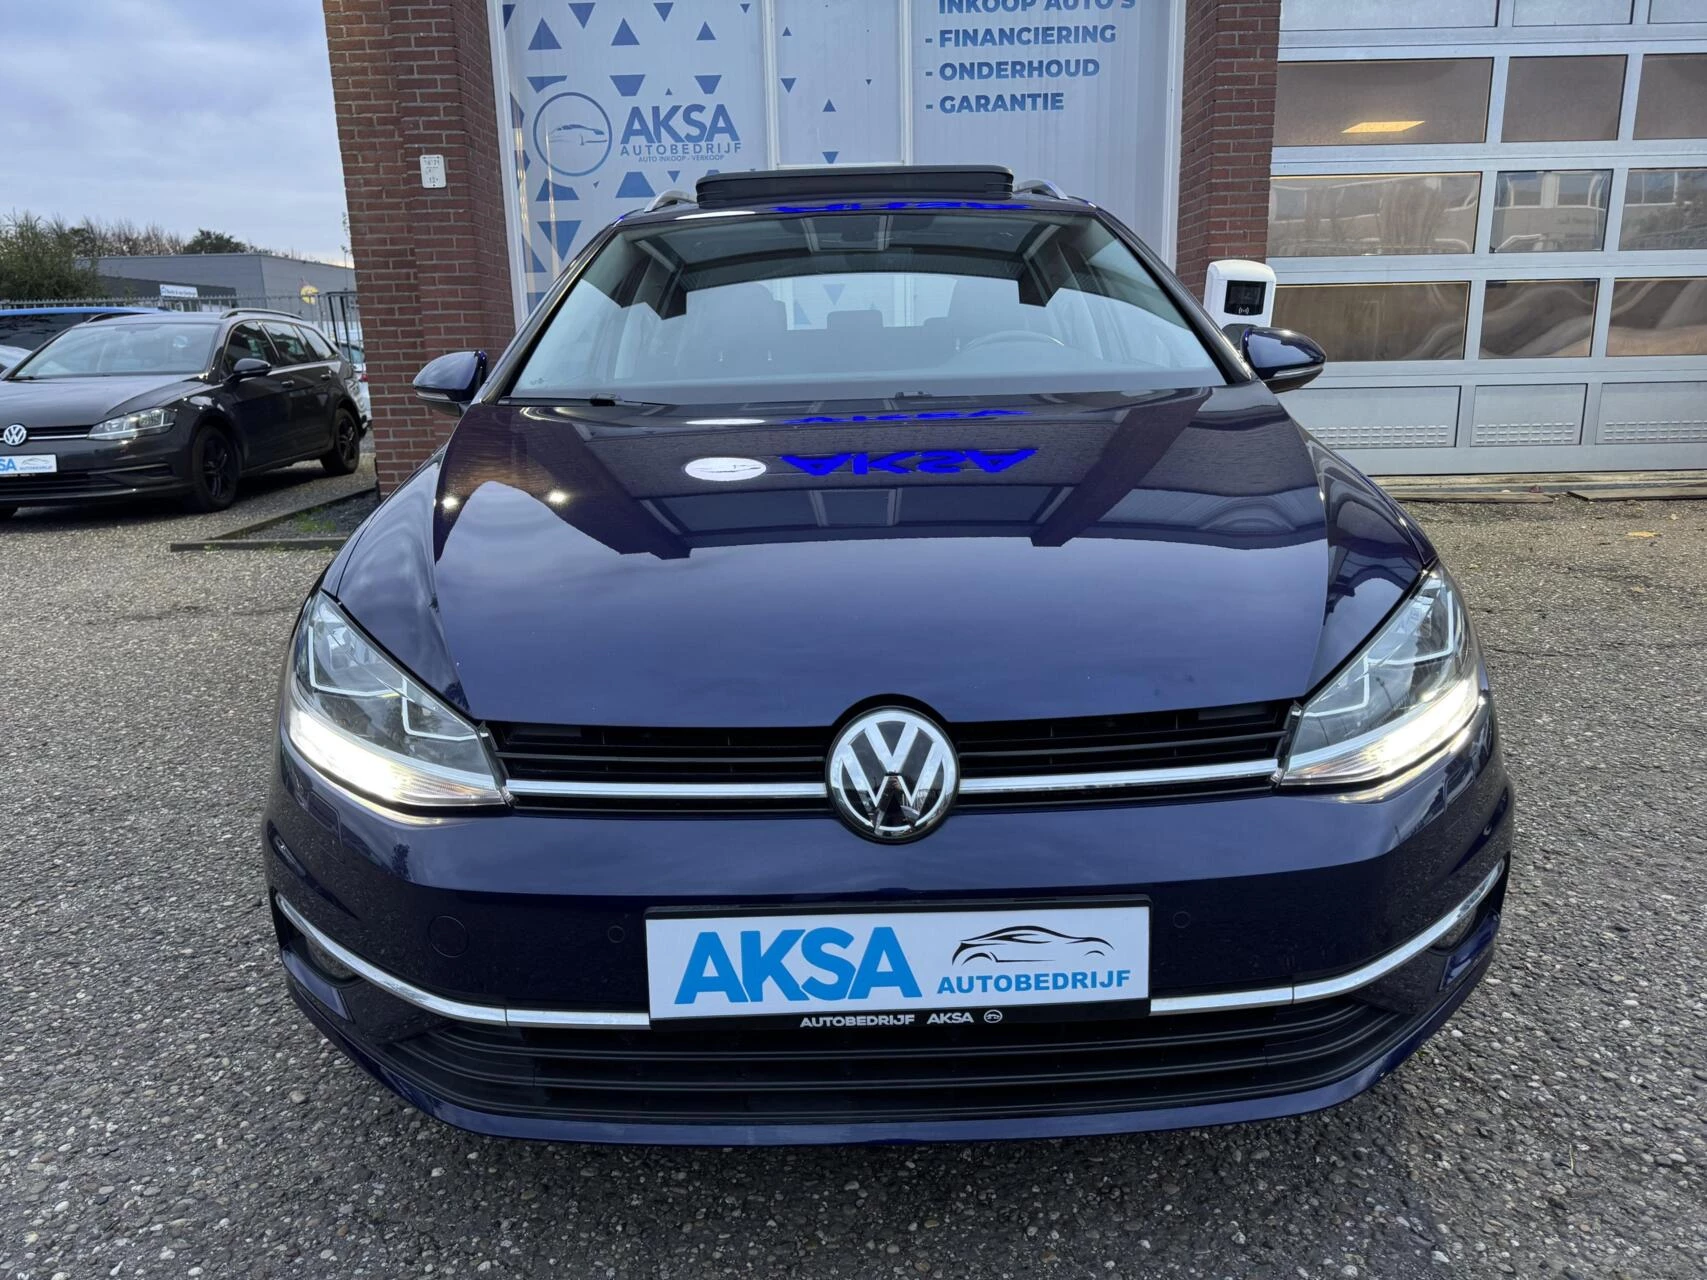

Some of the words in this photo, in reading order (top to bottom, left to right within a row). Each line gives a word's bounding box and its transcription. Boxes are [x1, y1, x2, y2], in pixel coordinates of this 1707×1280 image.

[939, 0, 1035, 14] INKOOP
[1043, 0, 1136, 10] AUTOS
[939, 24, 1117, 48] FINANCIERING
[939, 58, 1100, 81] ONDERHOUD
[939, 92, 1065, 114] GARANTIE
[620, 103, 741, 144] AKSA
[620, 142, 742, 157] AUTOBEDRIJF
[638, 155, 657, 163] AUTO
[692, 154, 725, 162] VERKOOP
[830, 710, 956, 838] VW
[674, 926, 923, 1005] AKSA
[937, 969, 1131, 995] AUTOBEDRIJF
[800, 1014, 915, 1028] AUTOBEDRIJF
[926, 1011, 975, 1025] AKSA
